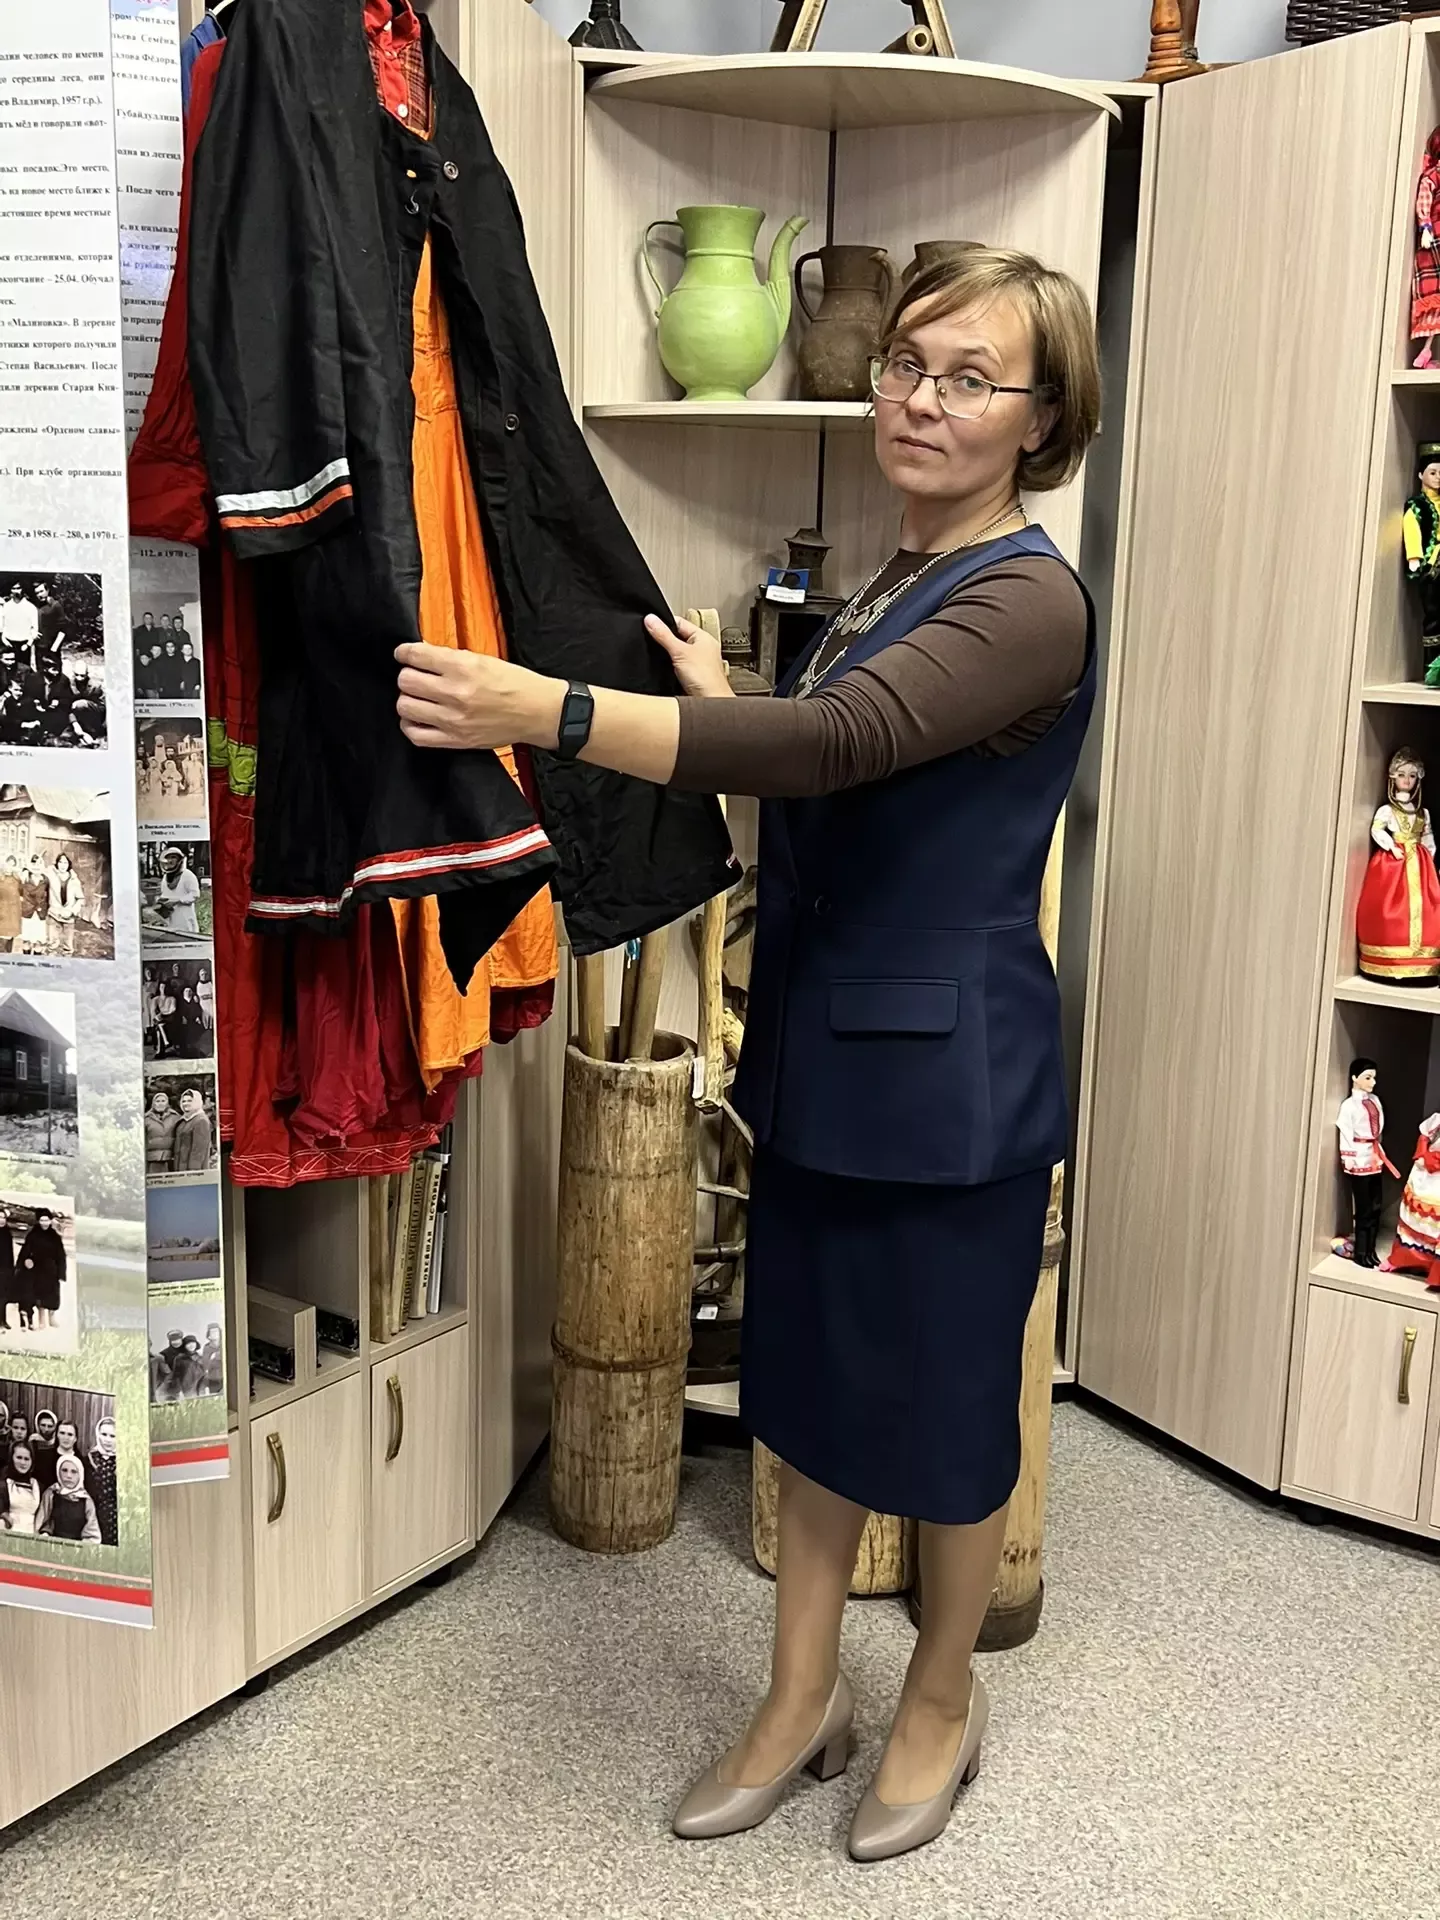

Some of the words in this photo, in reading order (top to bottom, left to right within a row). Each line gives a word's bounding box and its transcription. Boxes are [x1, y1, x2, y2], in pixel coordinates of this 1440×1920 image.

[75, 51, 104, 59] имени
[12, 76, 56, 86] середины
[88, 74, 105, 82] они
[62, 95, 81, 105] 1957
[116, 108, 180, 122] Губайдуллина
[16, 119, 32, 129] мёд
[41, 120, 82, 130] говорили
[82, 165, 110, 173] место,
[48, 187, 73, 195] место
[75, 186, 102, 194] ближе
[126, 184, 153, 196] После
[155, 189, 175, 198] чего
[44, 210, 71, 220] время
[74, 209, 111, 217] местные
[14, 254, 75, 262] отделениями,
[78, 254, 113, 263] которая
[73, 318, 79, 327] В
[83, 319, 116, 329] деревне
[33, 341, 72, 351] которого
[74, 341, 117, 351] получили
[34, 361, 88, 371] Васильевич.
[91, 361, 118, 371] После
[62, 383, 94, 394] Старая
[41, 425, 85, 436] «Орденом
[88, 427, 121, 435] славы»
[16, 466, 34, 477] При
[39, 467, 63, 478] клубе
[67, 468, 122, 478] организован
[8, 529, 24, 539] 289,
[33, 529, 52, 539] 1958
[92, 531, 111, 540] 1970
[413, 1176, 424, 1205] МИРА
[408, 1209, 420, 1261] ДРЕВНЕГО
[422, 1230, 433, 1288] НОВЕЙШАЯ
[428, 1174, 440, 1221] ИСТОРИЯ
[402, 1266, 413, 1314] ИСТОРИЯ
